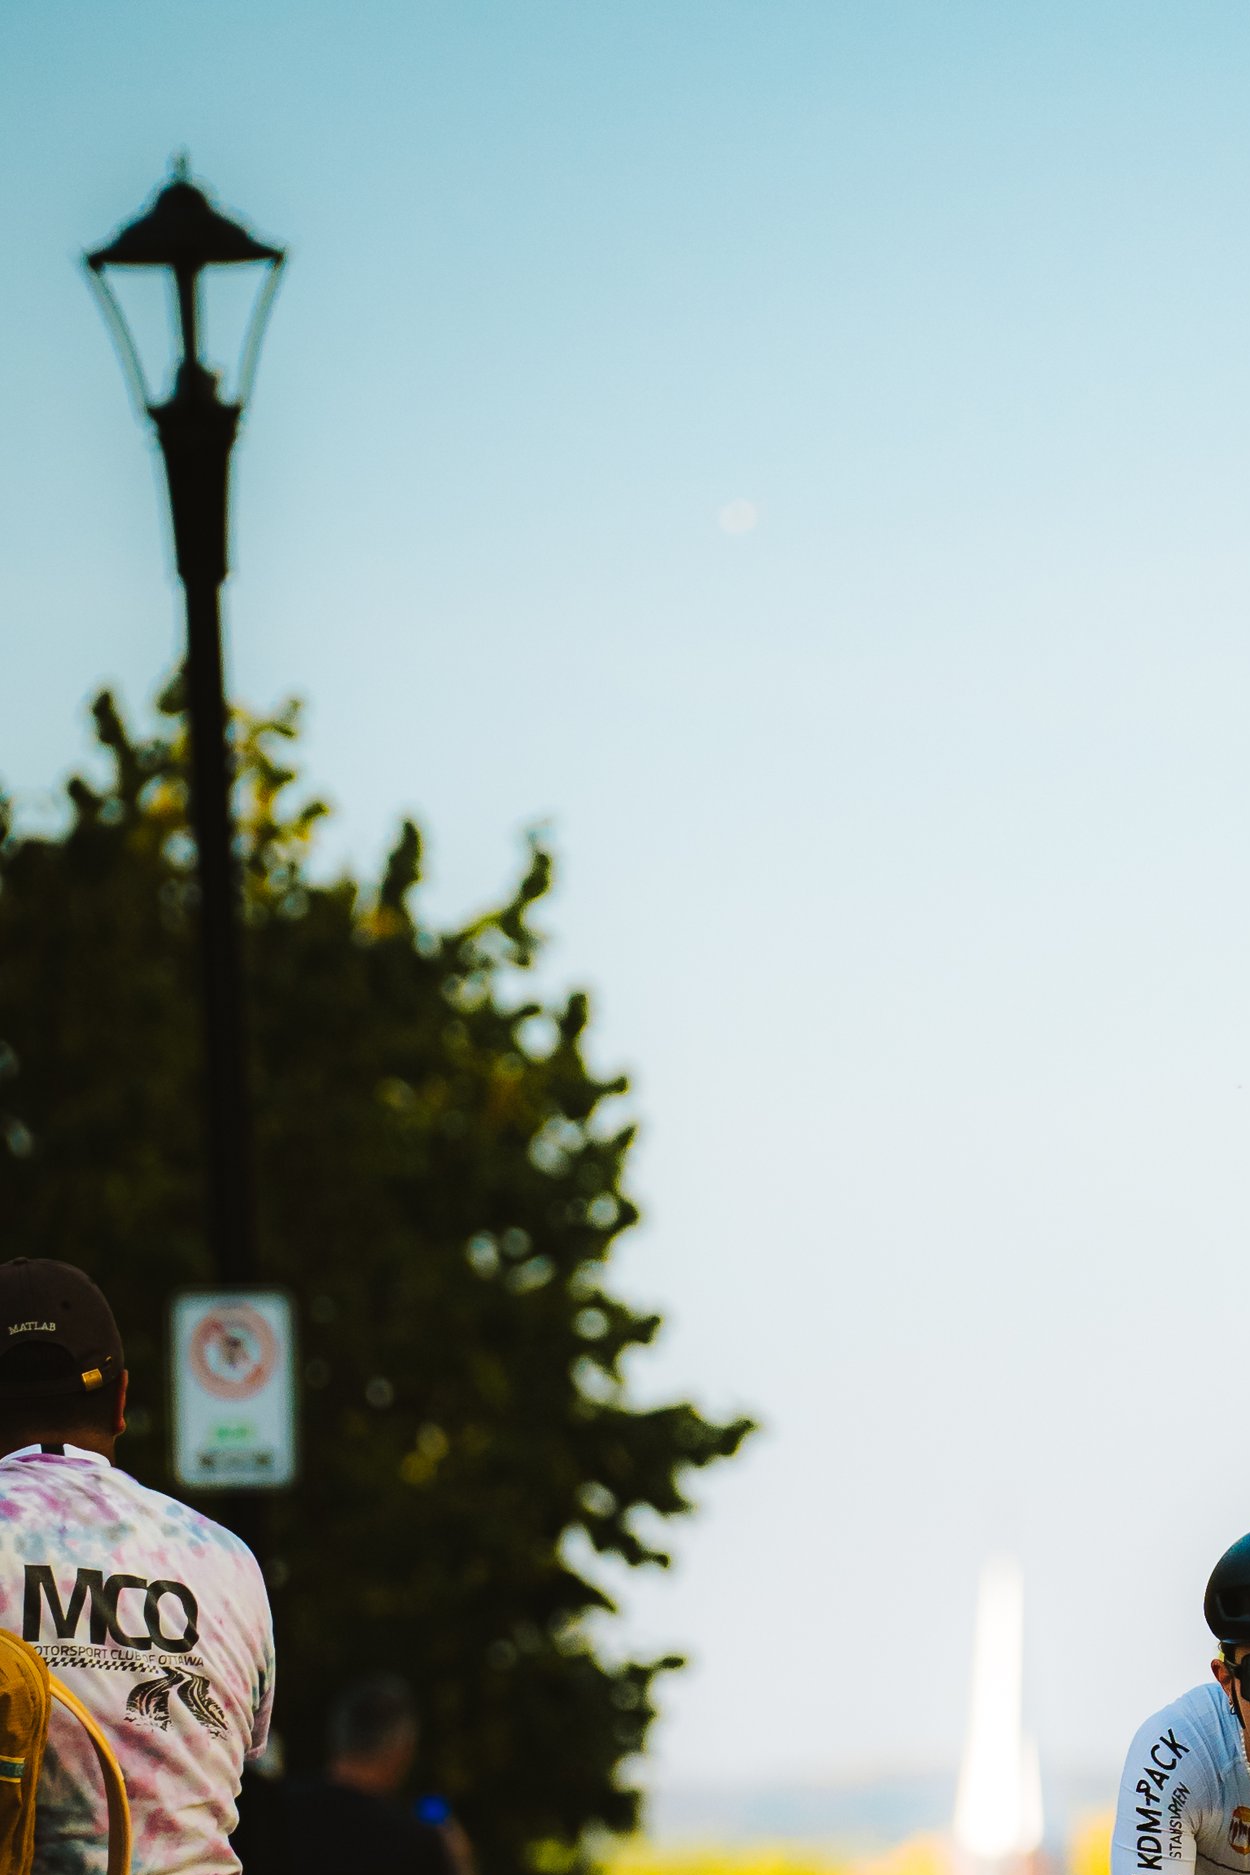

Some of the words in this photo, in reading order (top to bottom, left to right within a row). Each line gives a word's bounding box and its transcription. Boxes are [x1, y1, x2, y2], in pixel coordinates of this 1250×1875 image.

[8, 1321, 56, 1336] MATLAB
[22, 1564, 200, 1653] MCO
[34, 1645, 108, 1660] OTORSPORT
[110, 1649, 142, 1662] CLUB
[158, 1654, 204, 1668] OTTAWA
